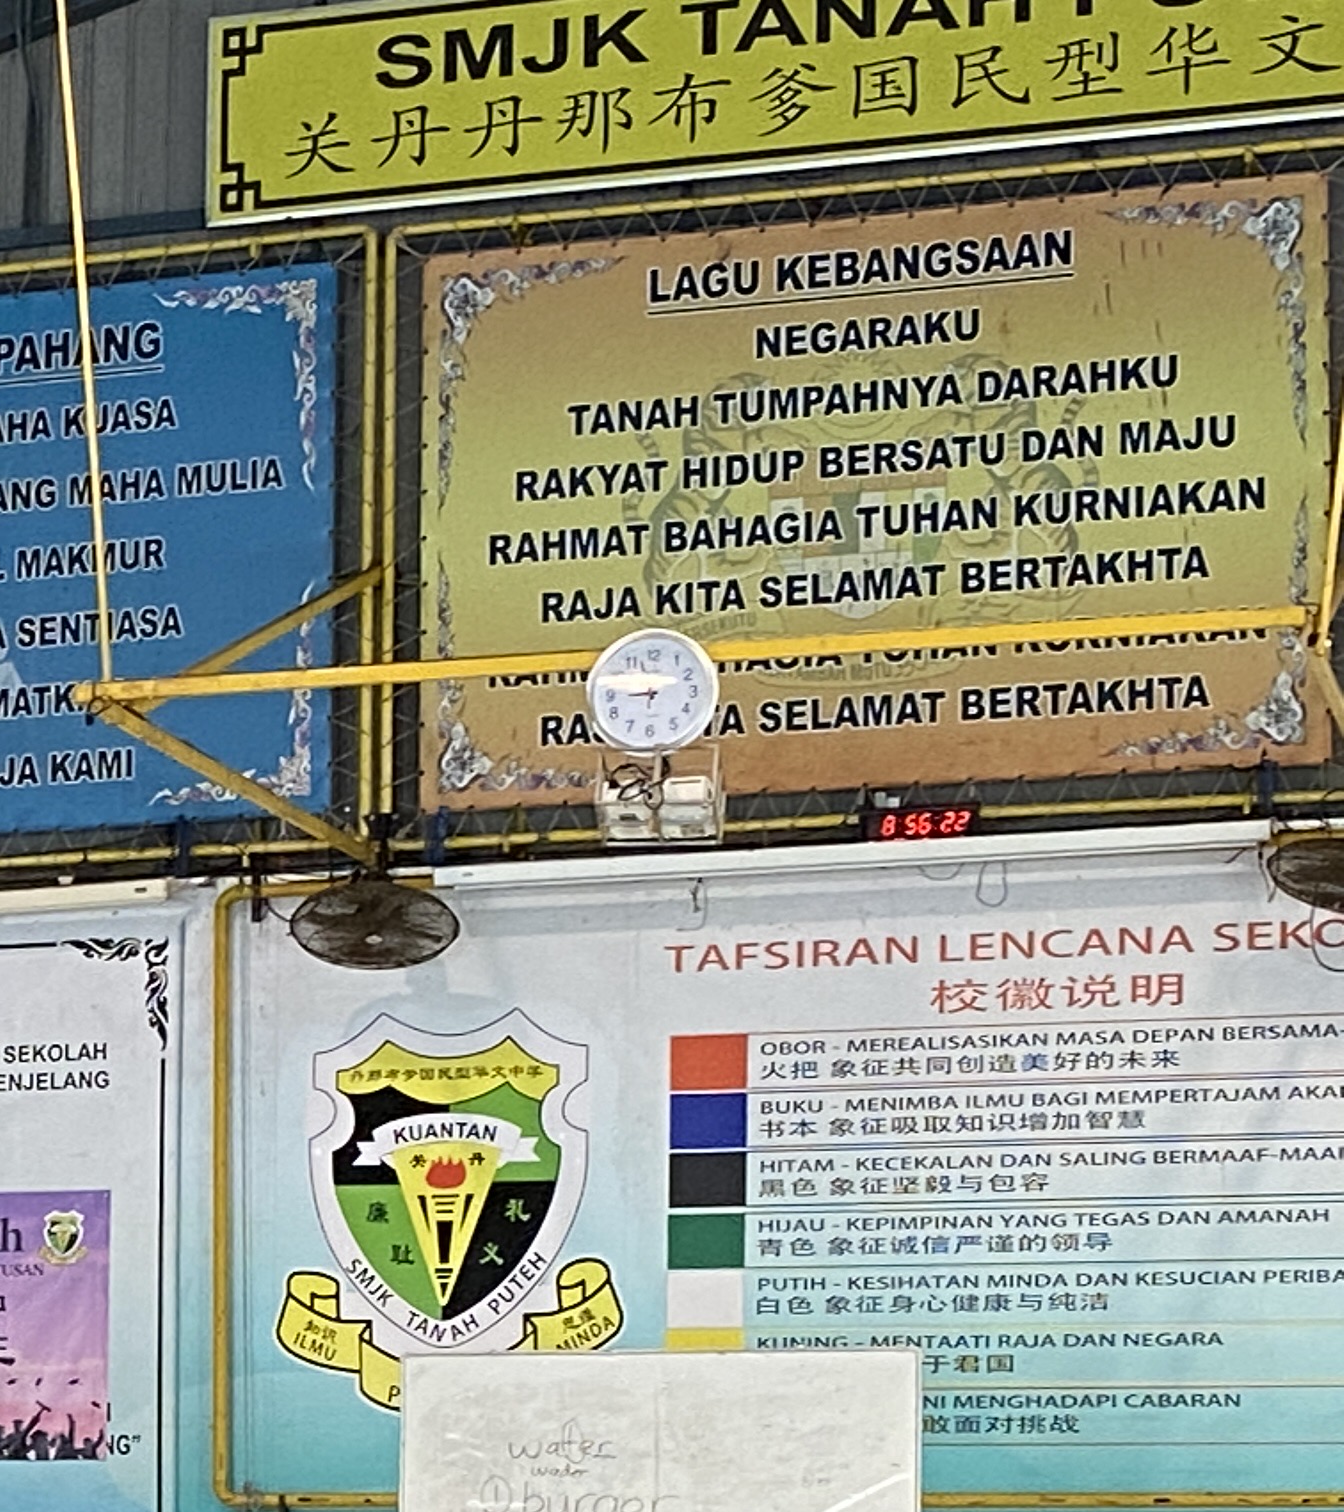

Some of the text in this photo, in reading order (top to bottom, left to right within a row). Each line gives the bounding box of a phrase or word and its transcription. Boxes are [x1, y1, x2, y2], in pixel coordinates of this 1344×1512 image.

[375, 8, 651, 90] SMJK
[647, 231, 1074, 307] LAGU KEBANGSAAN
[754, 307, 981, 359] NEGARAKU
[568, 355, 1179, 437] TANAH TUMPAHNYA DARAHKU
[63, 399, 178, 436] KUASA
[515, 414, 1237, 502] RAKYAT HIDUP BERSATU DAN MAJU
[68, 468, 165, 505] MAHA
[176, 458, 283, 498] MULIA
[489, 476, 1267, 566] RAHMAT BAHAGIA TUHAN KURNIAKAN
[541, 545, 1210, 624] RAJA KITA SELAMAT BERTAKHTA
[758, 682, 942, 733] SELAMAT
[960, 673, 1210, 719] BERTAKHTA
[48, 746, 134, 786] KAMI
[665, 936, 918, 972] TAFSIRAN
[940, 925, 1194, 962] LENCANA
[931, 973, 1185, 1014] 校徽说明
[2, 1043, 107, 1064] SEKOLAH
[761, 1027, 1214, 1056] OBOR MEREALISASIKAN MASA DEPAN
[761, 1060, 819, 1081] 火把
[760, 1085, 1281, 1114] BUKU MENIMBA ILMU BAGI MEMPERTAJAM
[393, 1121, 498, 1144] KUANTAN
[760, 1118, 816, 1138] 书本
[760, 1151, 1146, 1173] HITAM KECEKALAN DAN SALING
[758, 1178, 817, 1198] 黑色
[759, 1208, 1330, 1233] HIJAU KEPIMPINAN YANG TEGAS DAN AMANAH
[346, 1251, 547, 1342] SMJK TANAH PUTEH
[758, 1271, 1256, 1292] PUTIH KESIHATAN MINDA DAN KESUCIAN
[756, 1296, 813, 1315] 白色
[293, 1332, 337, 1361] ILMU
[997, 1332, 1223, 1348] RAJA DAN NEGARA
[954, 1392, 1241, 1409] MENGHADAPI CABARAN
